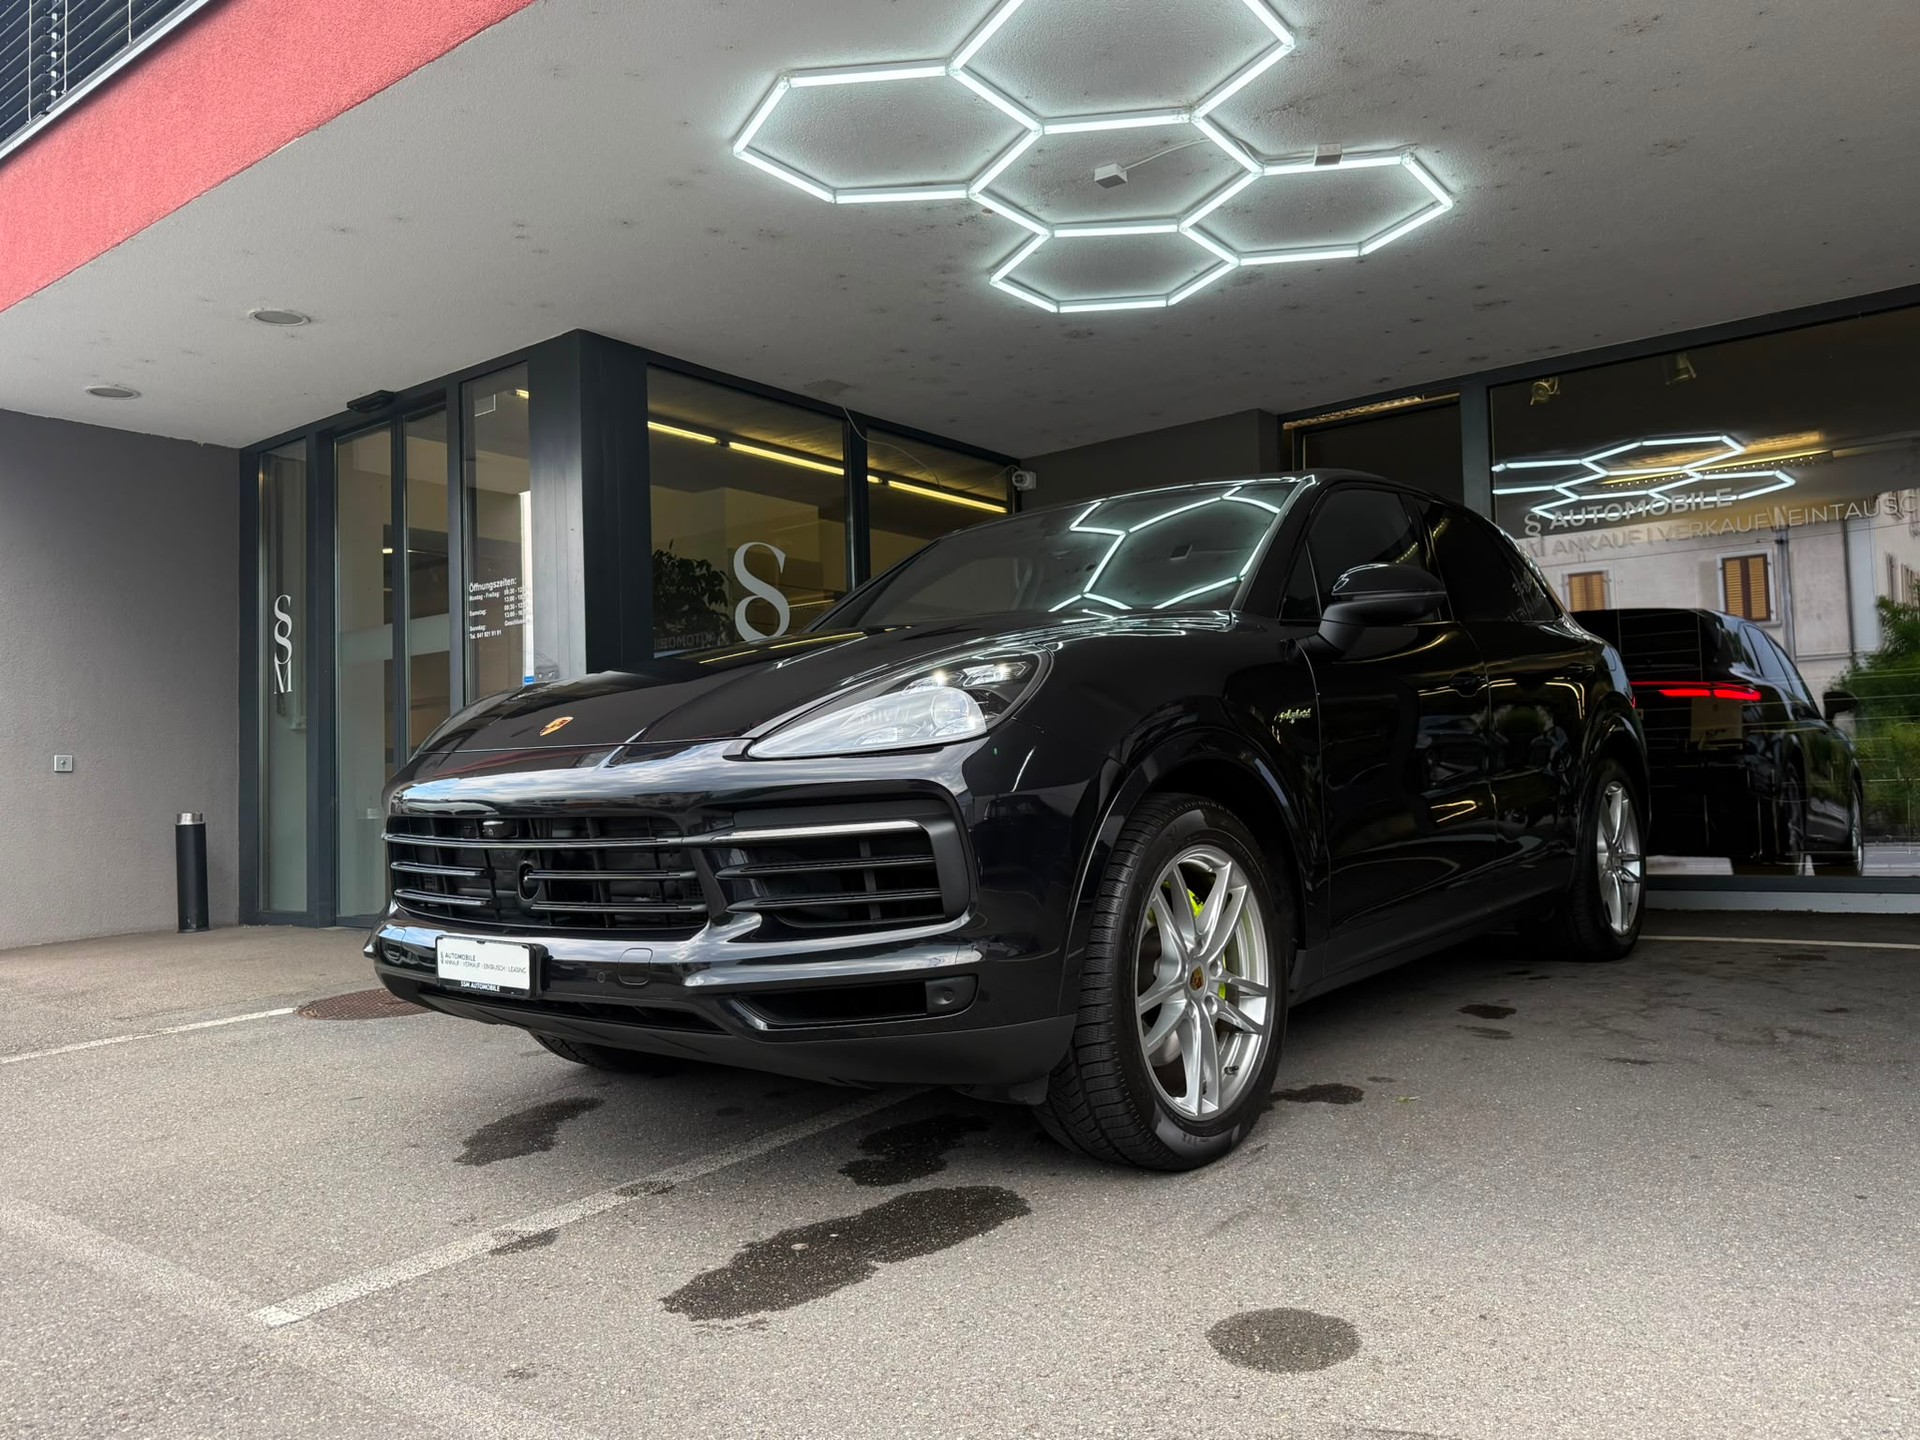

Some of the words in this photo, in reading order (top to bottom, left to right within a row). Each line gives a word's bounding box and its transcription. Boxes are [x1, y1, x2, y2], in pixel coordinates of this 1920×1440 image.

[1549, 487, 1734, 530] AUTOMOBILE
[1551, 529, 1643, 557] ANKAUF
[1656, 512, 1770, 543] VERKAUF
[445, 952, 476, 962] AUTOMOBILE
[470, 981, 500, 992] AUTOMOBILE
